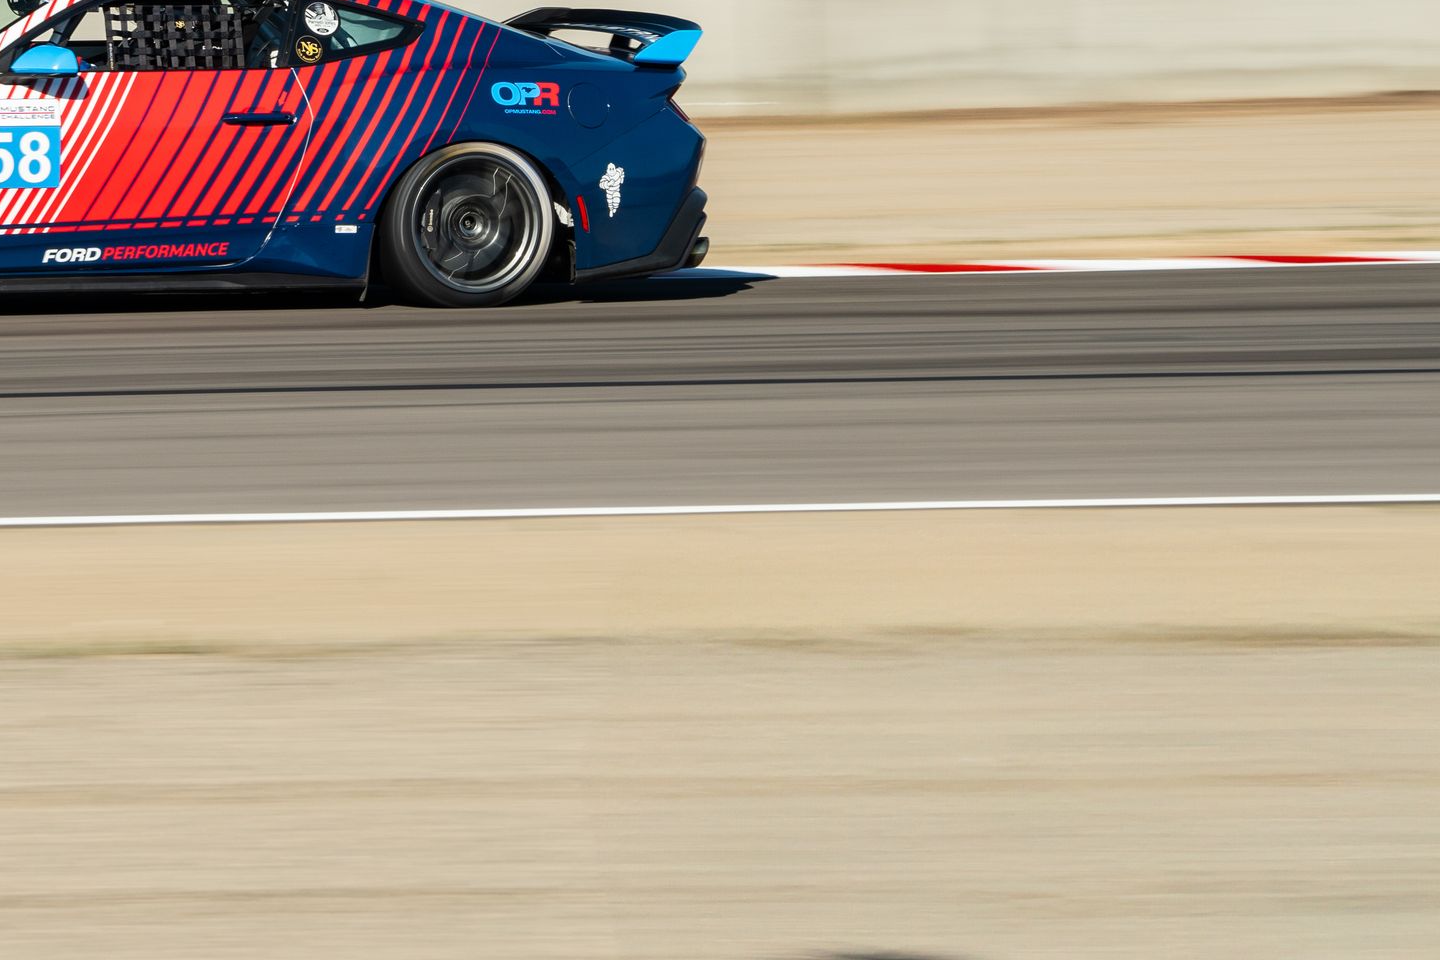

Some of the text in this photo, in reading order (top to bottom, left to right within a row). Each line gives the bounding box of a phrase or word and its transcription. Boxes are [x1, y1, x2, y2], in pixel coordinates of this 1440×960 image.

[491, 81, 560, 107] OPR
[42, 242, 230, 264] FORD PERFORMANCE
